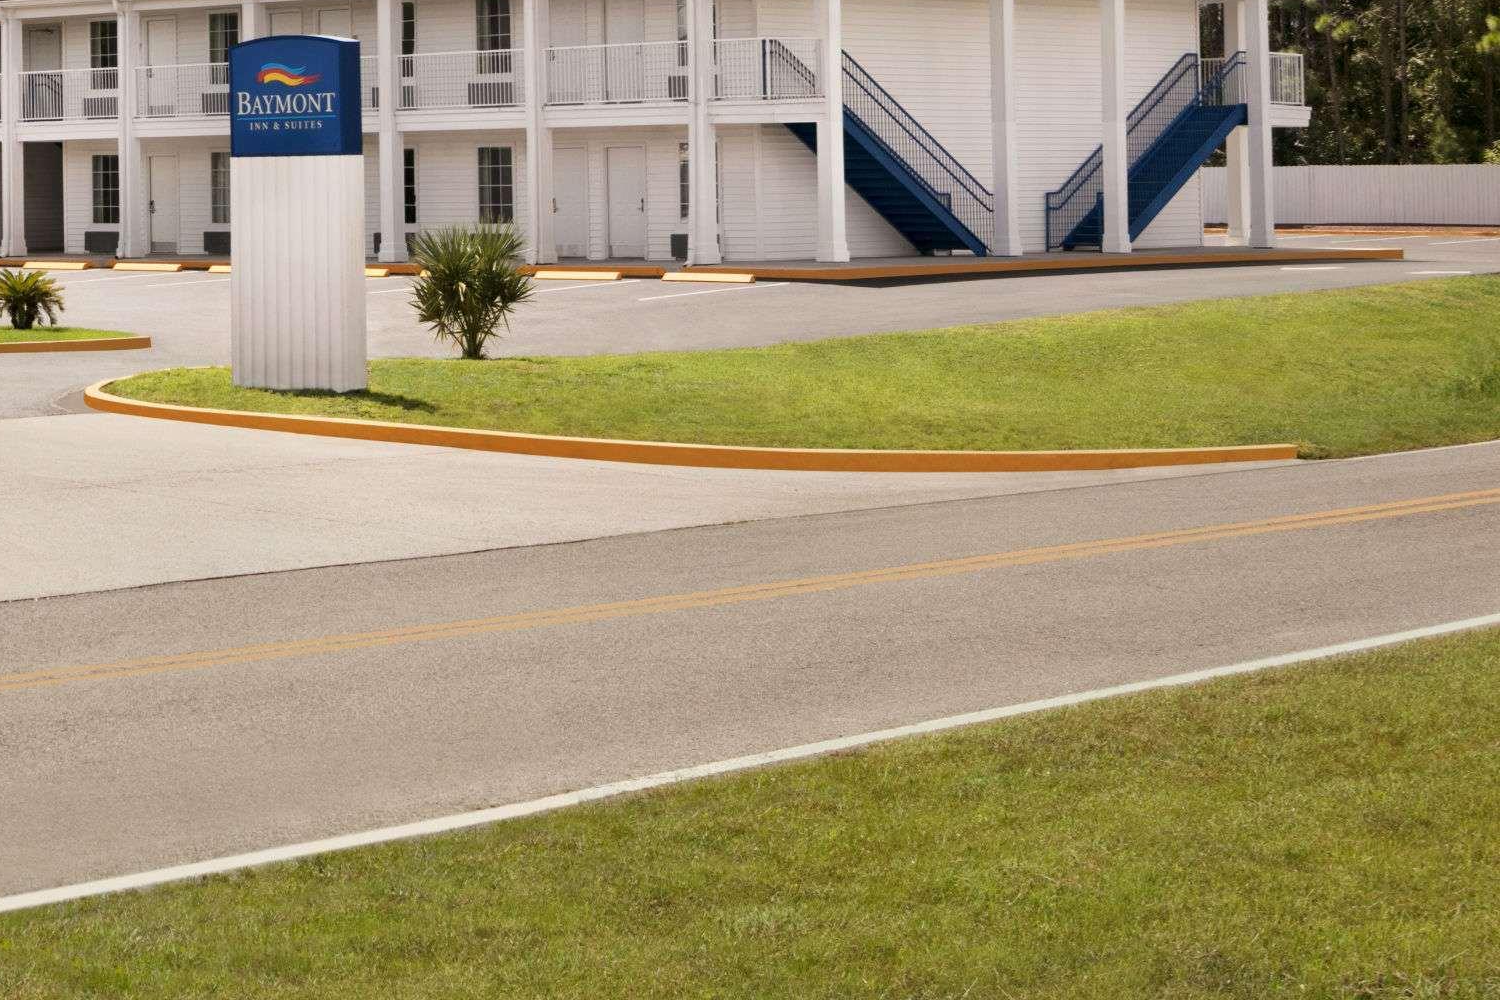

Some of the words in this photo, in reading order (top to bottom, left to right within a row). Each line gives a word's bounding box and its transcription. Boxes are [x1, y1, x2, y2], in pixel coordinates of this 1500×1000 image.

[237, 91, 336, 115] BAYMONT
[249, 122, 269, 130] INN
[273, 121, 281, 130] &
[284, 120, 323, 130] SUITES
